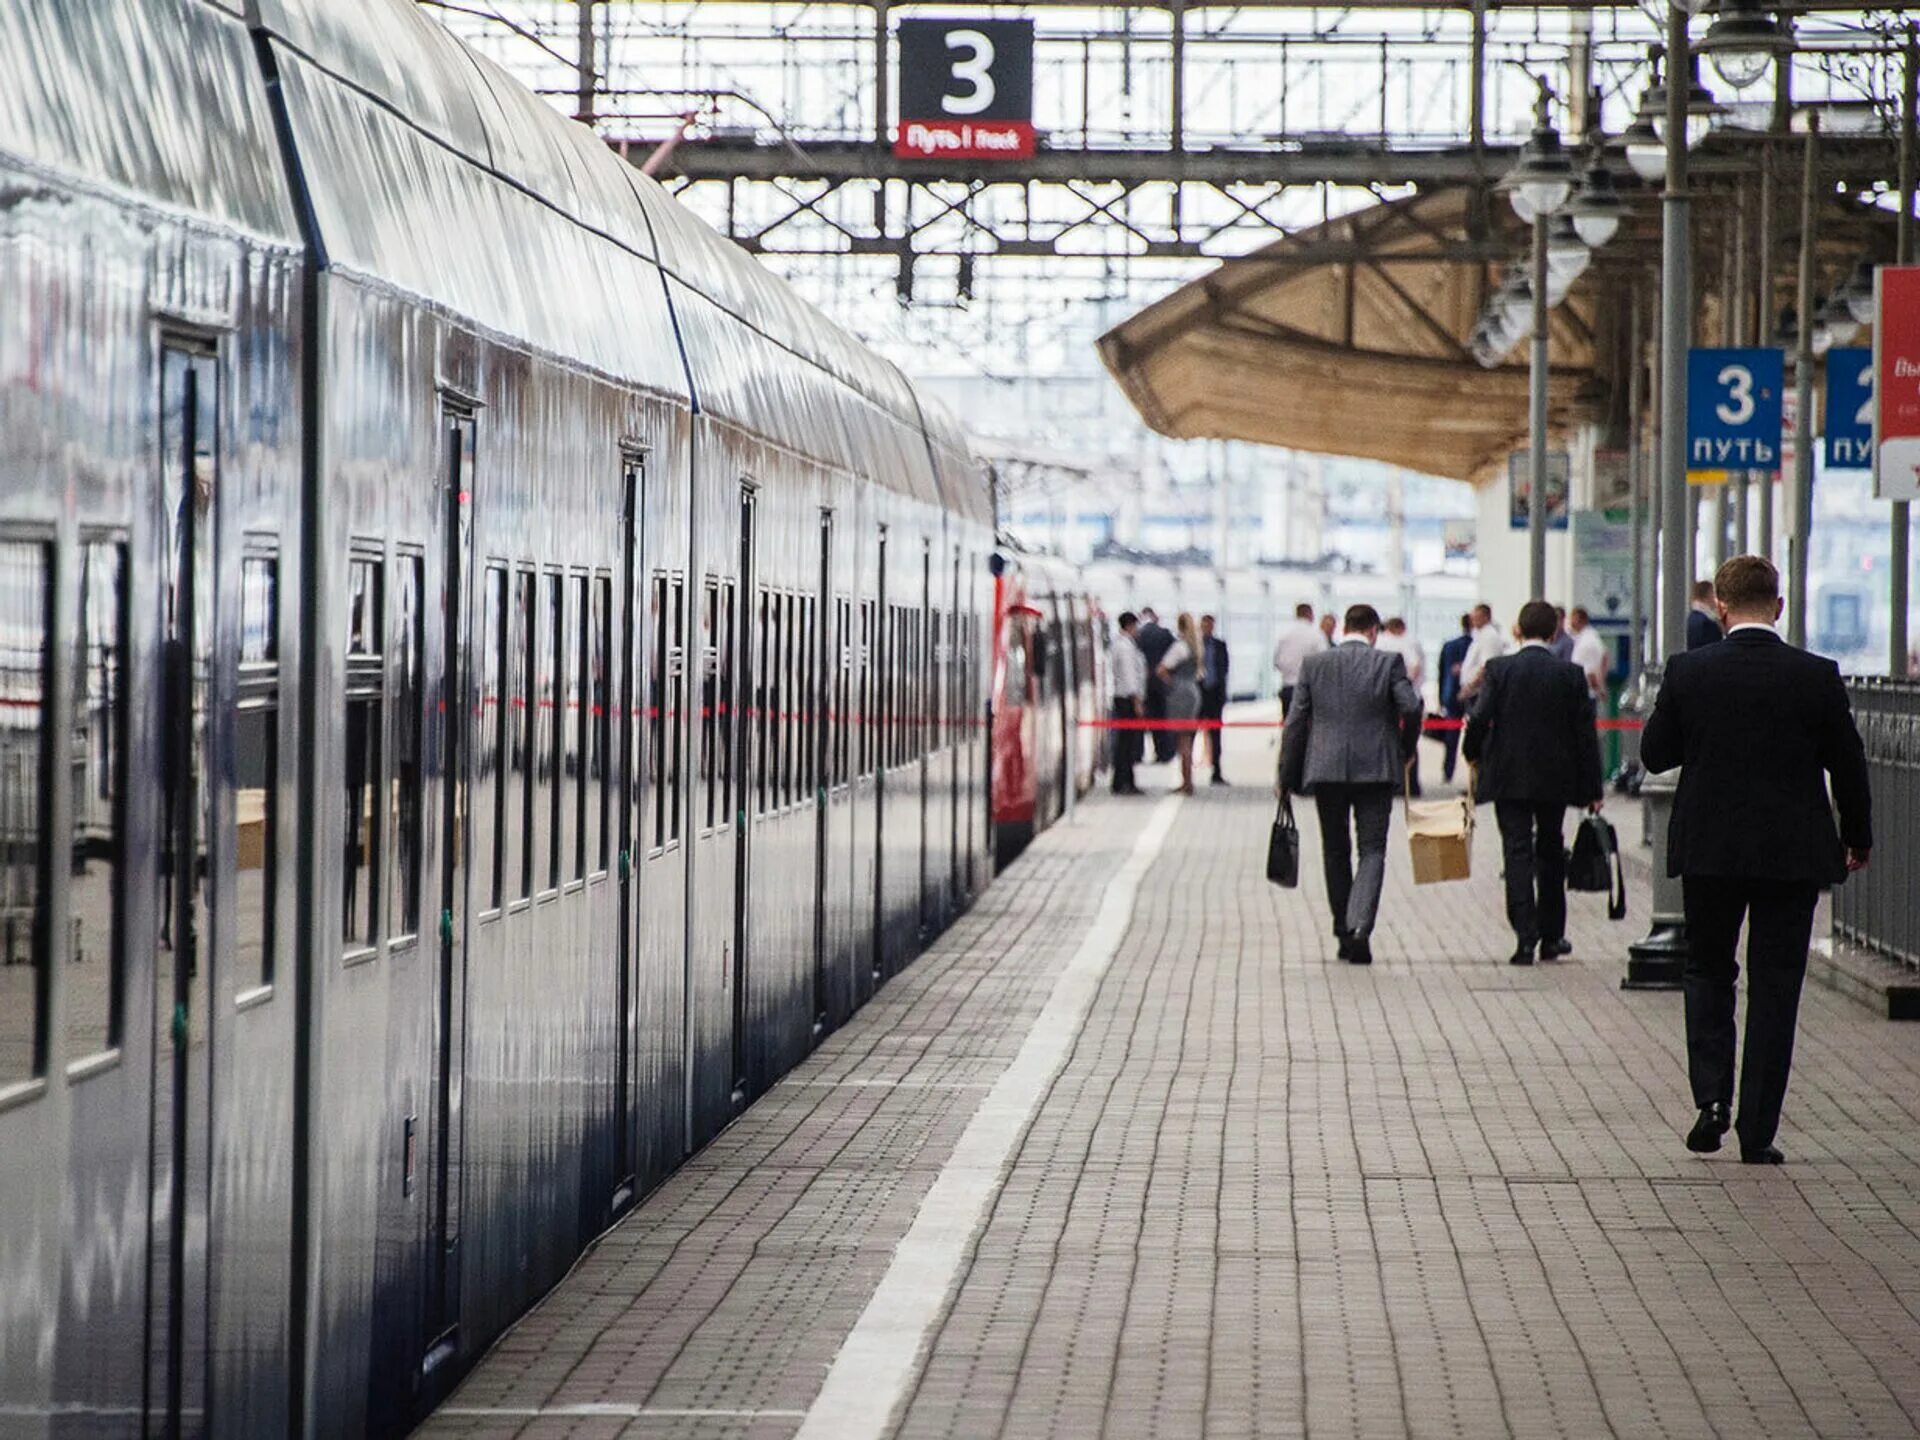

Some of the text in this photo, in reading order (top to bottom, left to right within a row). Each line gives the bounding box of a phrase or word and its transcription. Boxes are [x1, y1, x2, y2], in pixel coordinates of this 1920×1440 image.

[942, 29, 996, 115] 3
[1716, 365, 1756, 425] 3
[1693, 437, 1773, 462] ПУТЬ
